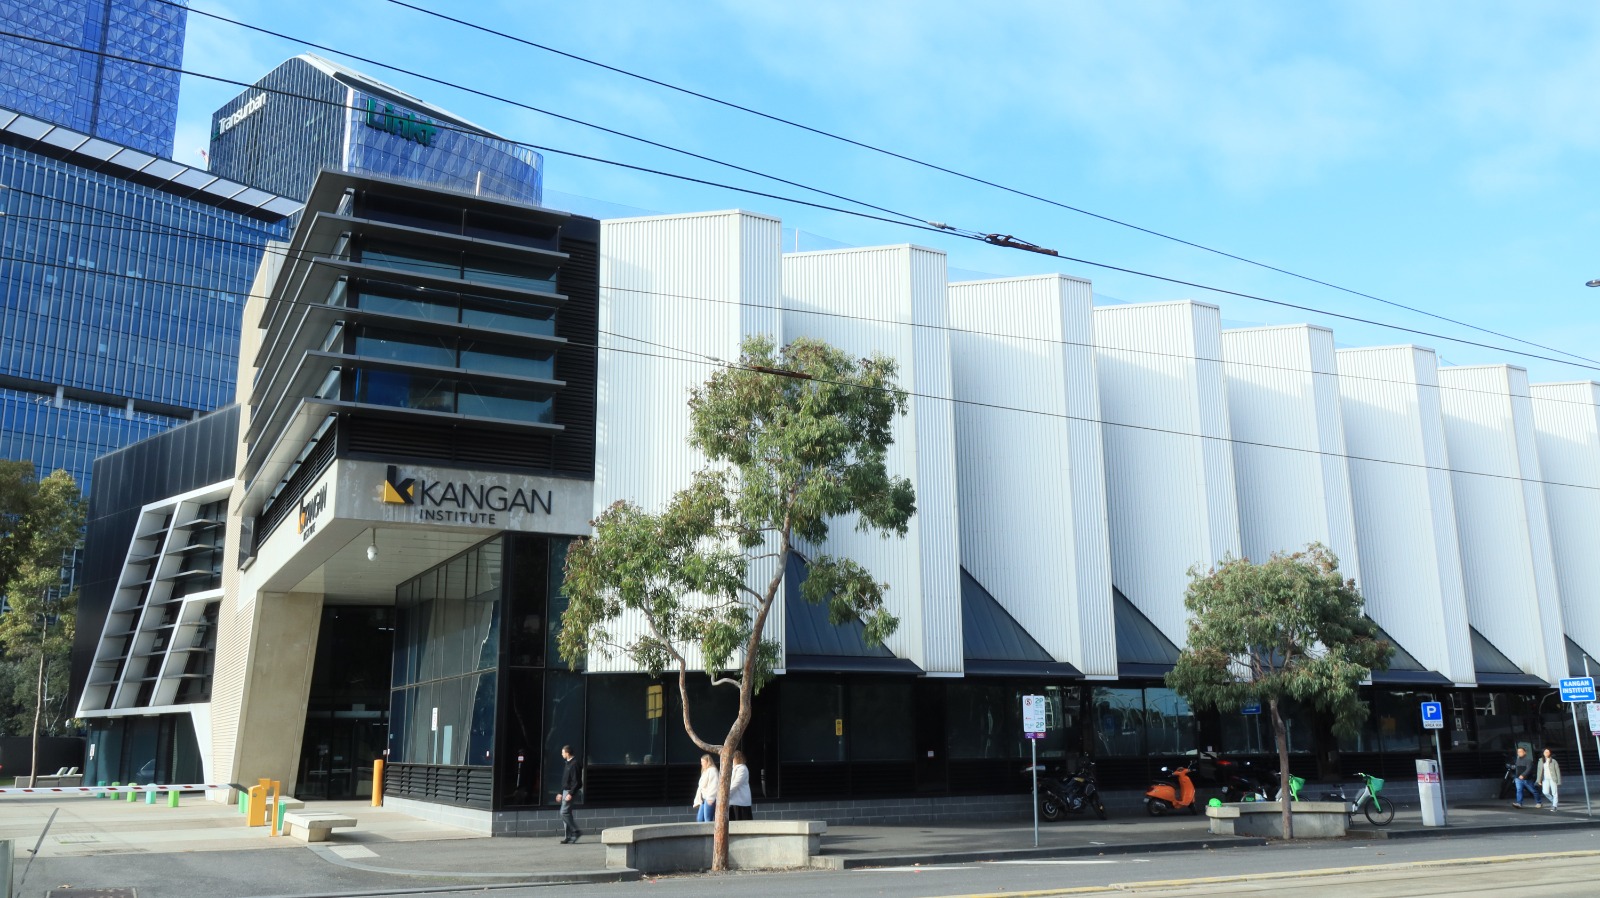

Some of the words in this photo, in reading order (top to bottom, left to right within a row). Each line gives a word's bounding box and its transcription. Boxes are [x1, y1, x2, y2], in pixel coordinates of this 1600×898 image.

[219, 92, 267, 135] Transurban
[366, 97, 437, 148] Linkt
[421, 480, 552, 515] KANGAN
[420, 509, 496, 524] INSTITUTE
[1562, 686, 1593, 694] INSTITUTE
[1426, 705, 1437, 718] P
